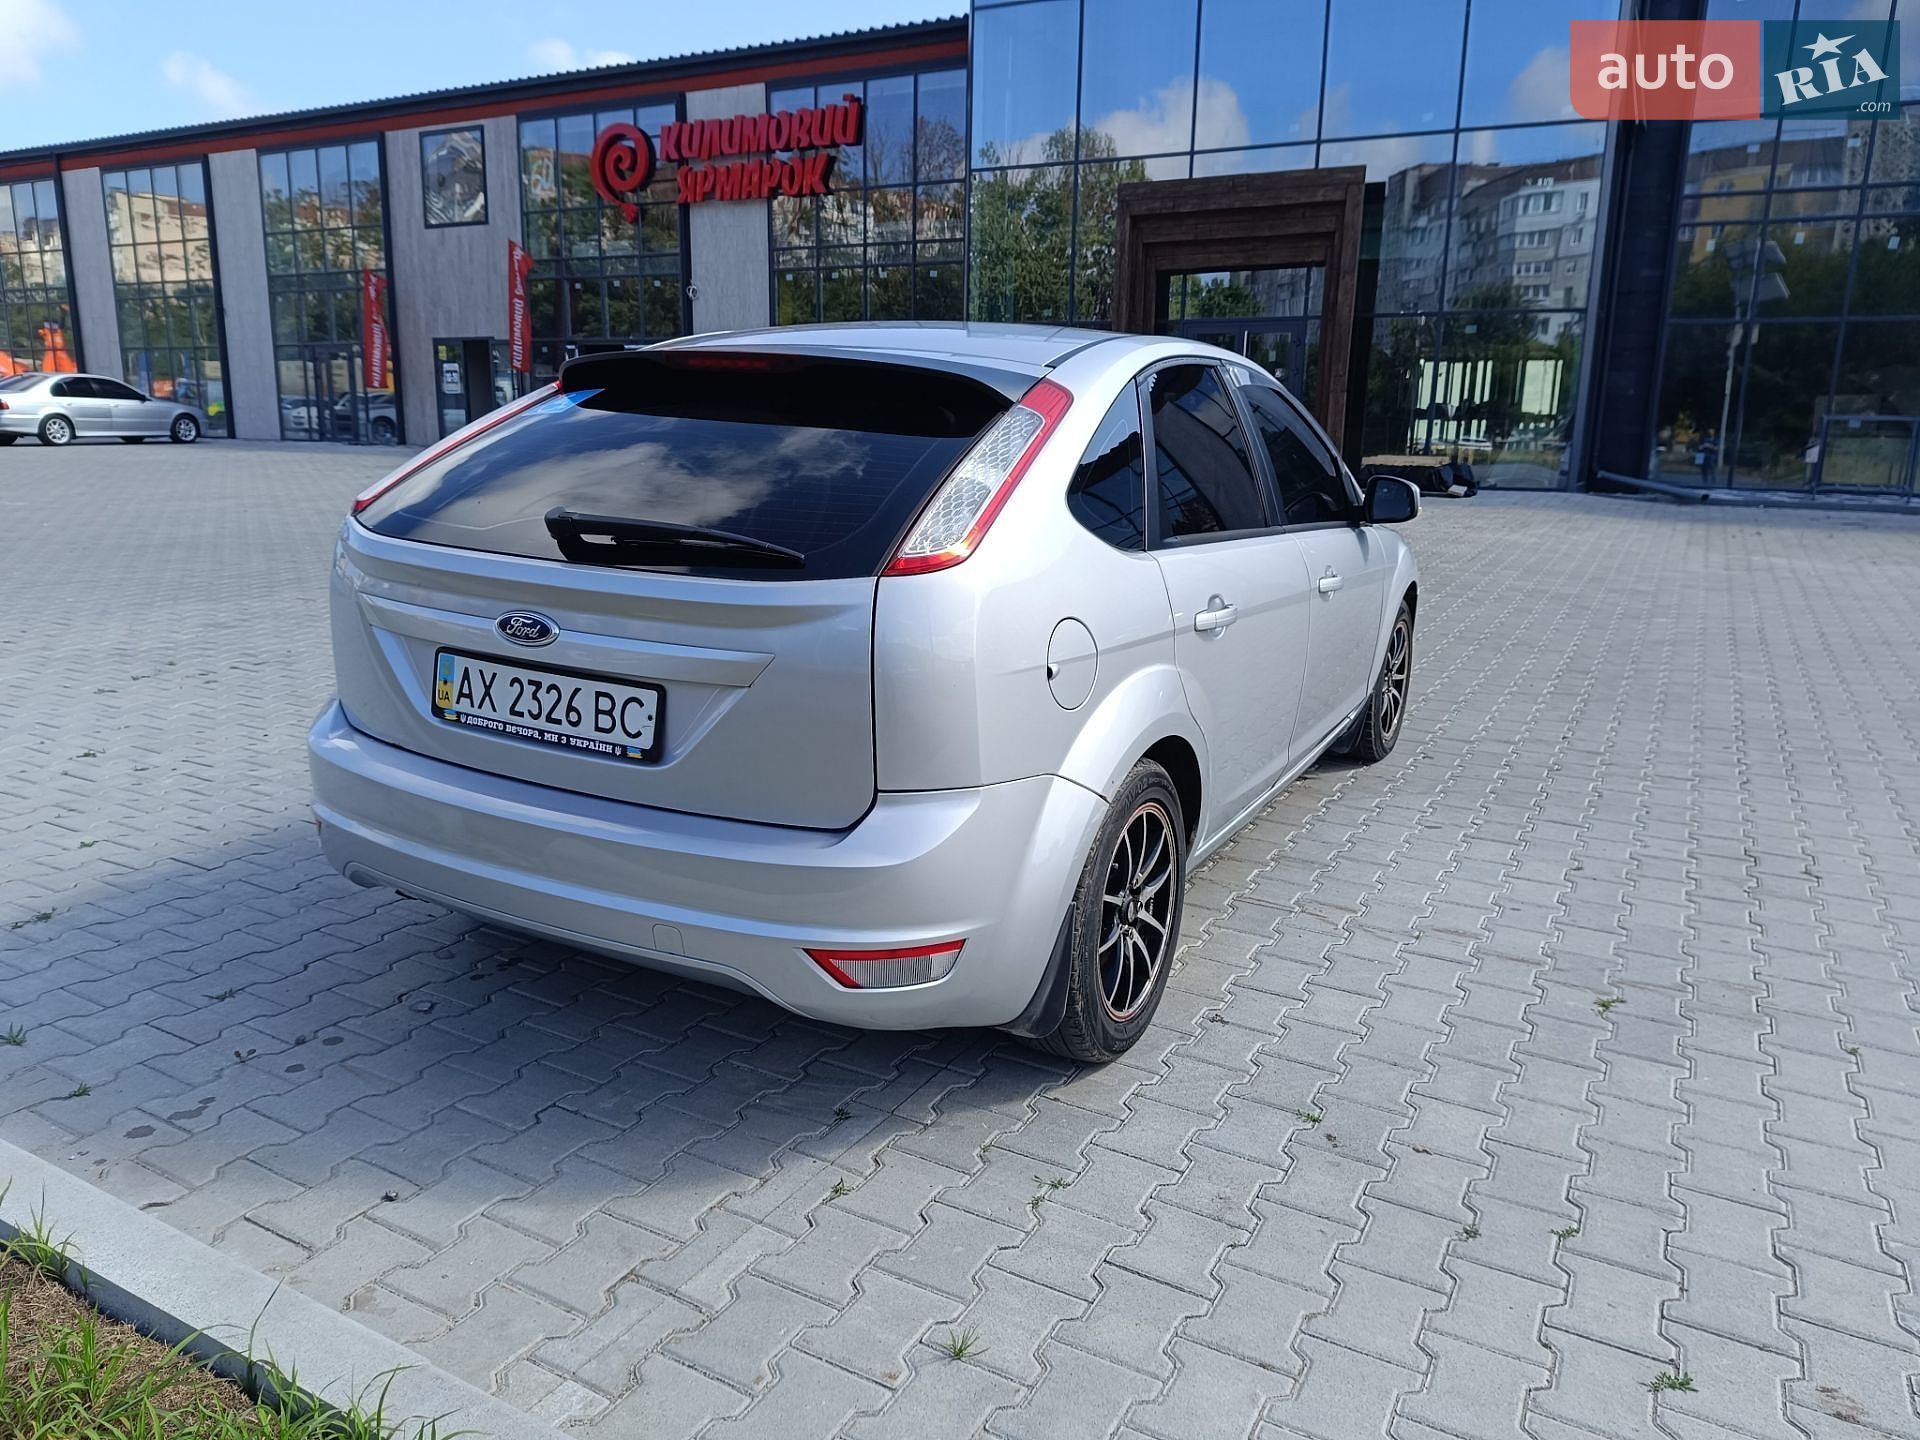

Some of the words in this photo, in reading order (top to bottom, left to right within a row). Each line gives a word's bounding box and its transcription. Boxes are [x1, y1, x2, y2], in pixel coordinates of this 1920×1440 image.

[660, 93, 864, 161] КИЛИМОВИЙ
[676, 152, 831, 204] ЯРМАРОК
[506, 616, 541, 638] Ford
[438, 689, 451, 703] UA
[455, 666, 498, 713] AX
[508, 676, 583, 728] 2326
[594, 690, 646, 739] BC
[467, 716, 504, 730] ДОБРОГО
[543, 732, 559, 743] МИ
[569, 737, 613, 754] УКРАЇНИ
